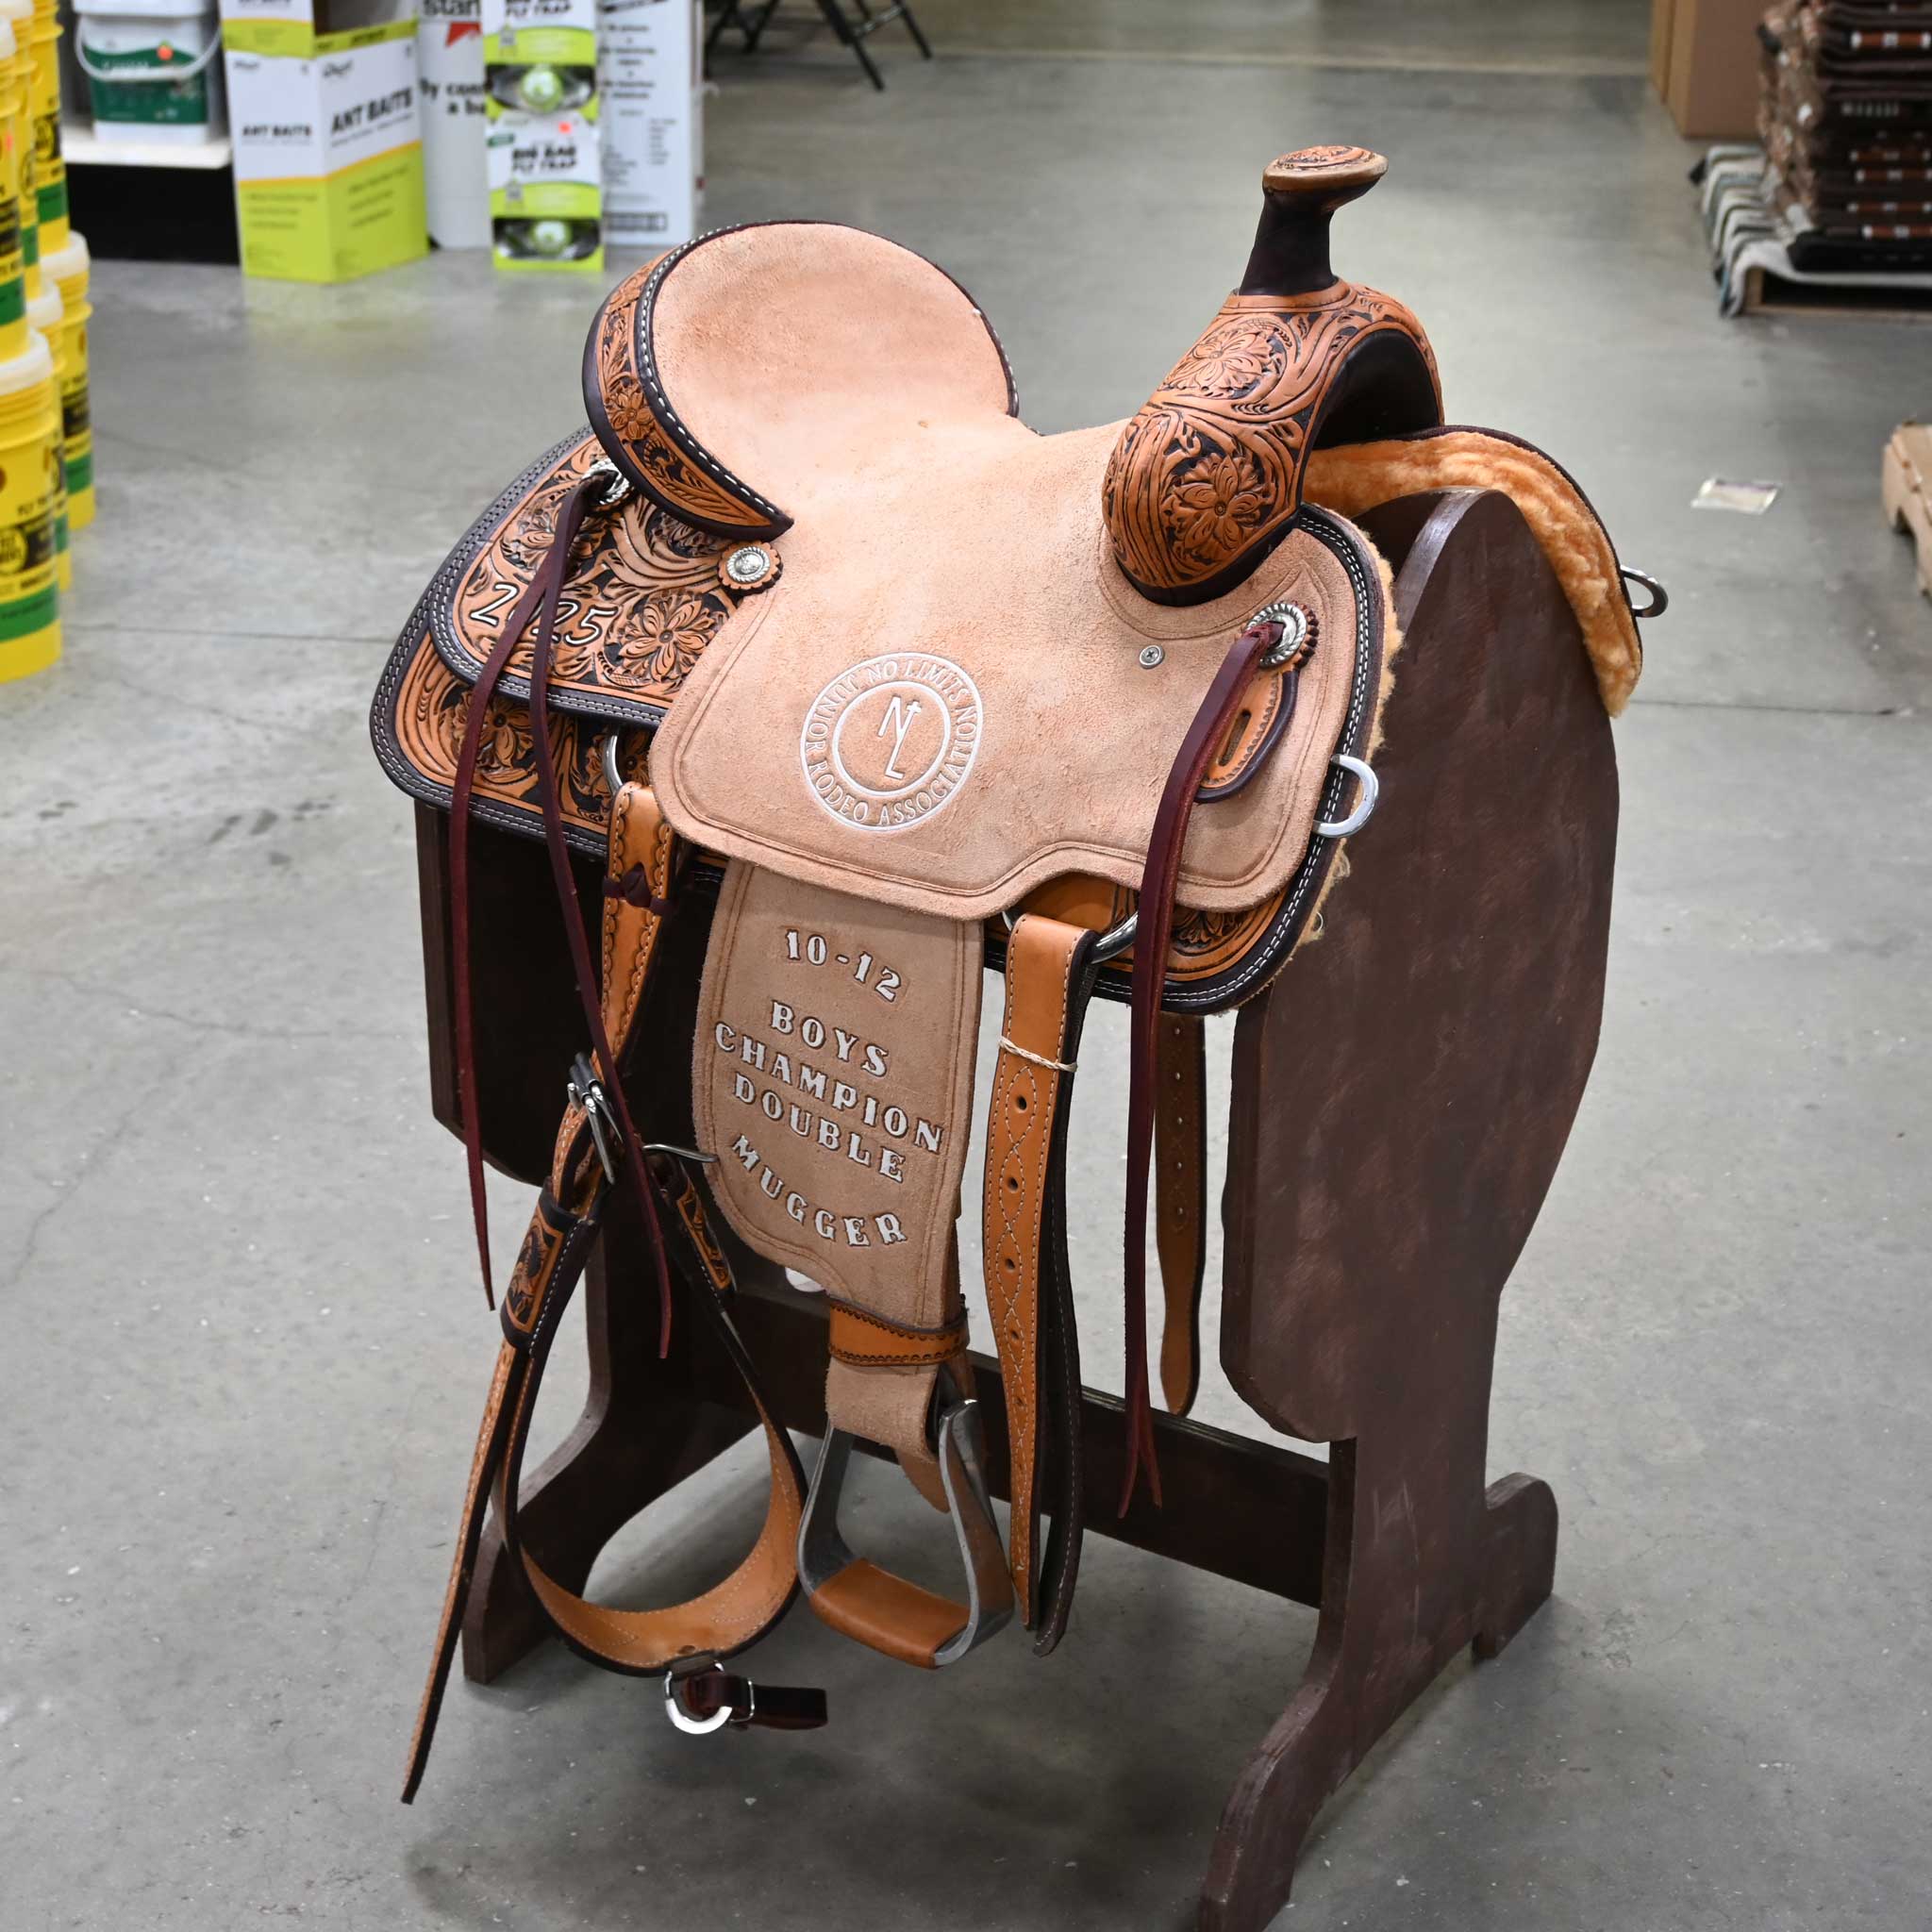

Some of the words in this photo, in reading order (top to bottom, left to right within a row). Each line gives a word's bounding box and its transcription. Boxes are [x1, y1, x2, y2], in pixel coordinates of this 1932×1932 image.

[242, 125, 268, 136] ANT
[273, 124, 312, 136] BAITS
[332, 105, 363, 133] ANT
[368, 87, 412, 120] BAITS
[805, 673, 860, 753] JUNIOR
[867, 660, 898, 684] NO
[904, 659, 970, 702] LIMITS
[808, 758, 869, 823] RODEO
[877, 705, 977, 826] ASSOCIATION
[785, 929, 903, 1003] 10-12
[771, 1001, 889, 1077] BOYS
[714, 1022, 944, 1154] CHAMPION
[734, 1074, 907, 1183] DOUBLE
[732, 1135, 907, 1247] MUGGER
